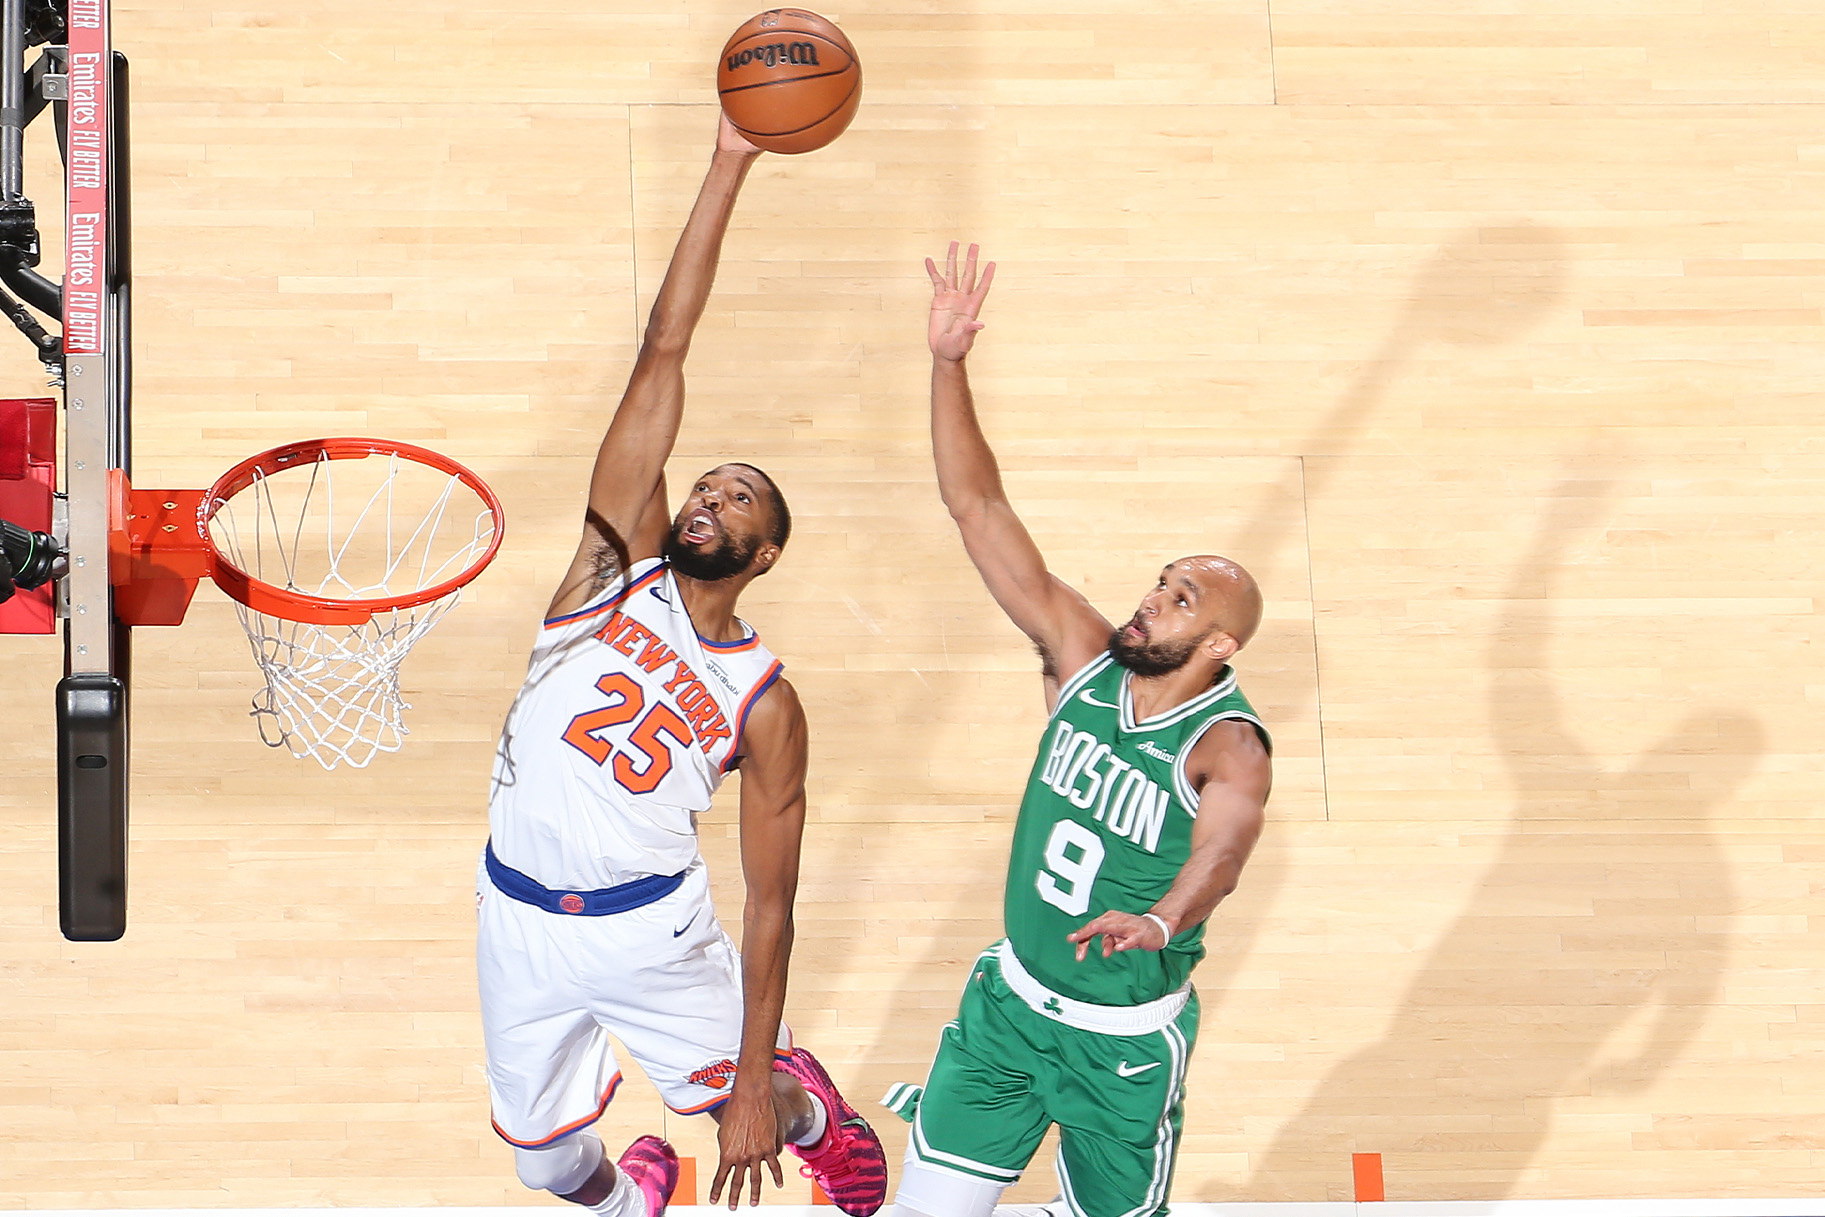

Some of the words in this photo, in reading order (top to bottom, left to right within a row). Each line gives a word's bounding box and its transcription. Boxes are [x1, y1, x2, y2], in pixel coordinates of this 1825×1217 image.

[727, 41, 820, 72] Wilson
[73, 52, 101, 125] Emirates
[73, 130, 100, 148] FLY
[73, 150, 101, 188] BETTER
[70, 212, 101, 286] Emirates
[69, 291, 98, 310] FLY
[68, 311, 98, 350] BETTER
[594, 610, 678, 674] NEW
[662, 660, 733, 754] YORK
[561, 671, 694, 795] 25
[1135, 740, 1176, 764] Amica
[1039, 719, 1171, 854] BOSTON
[1034, 818, 1106, 917] 9
[689, 1059, 738, 1083] KNICKS
